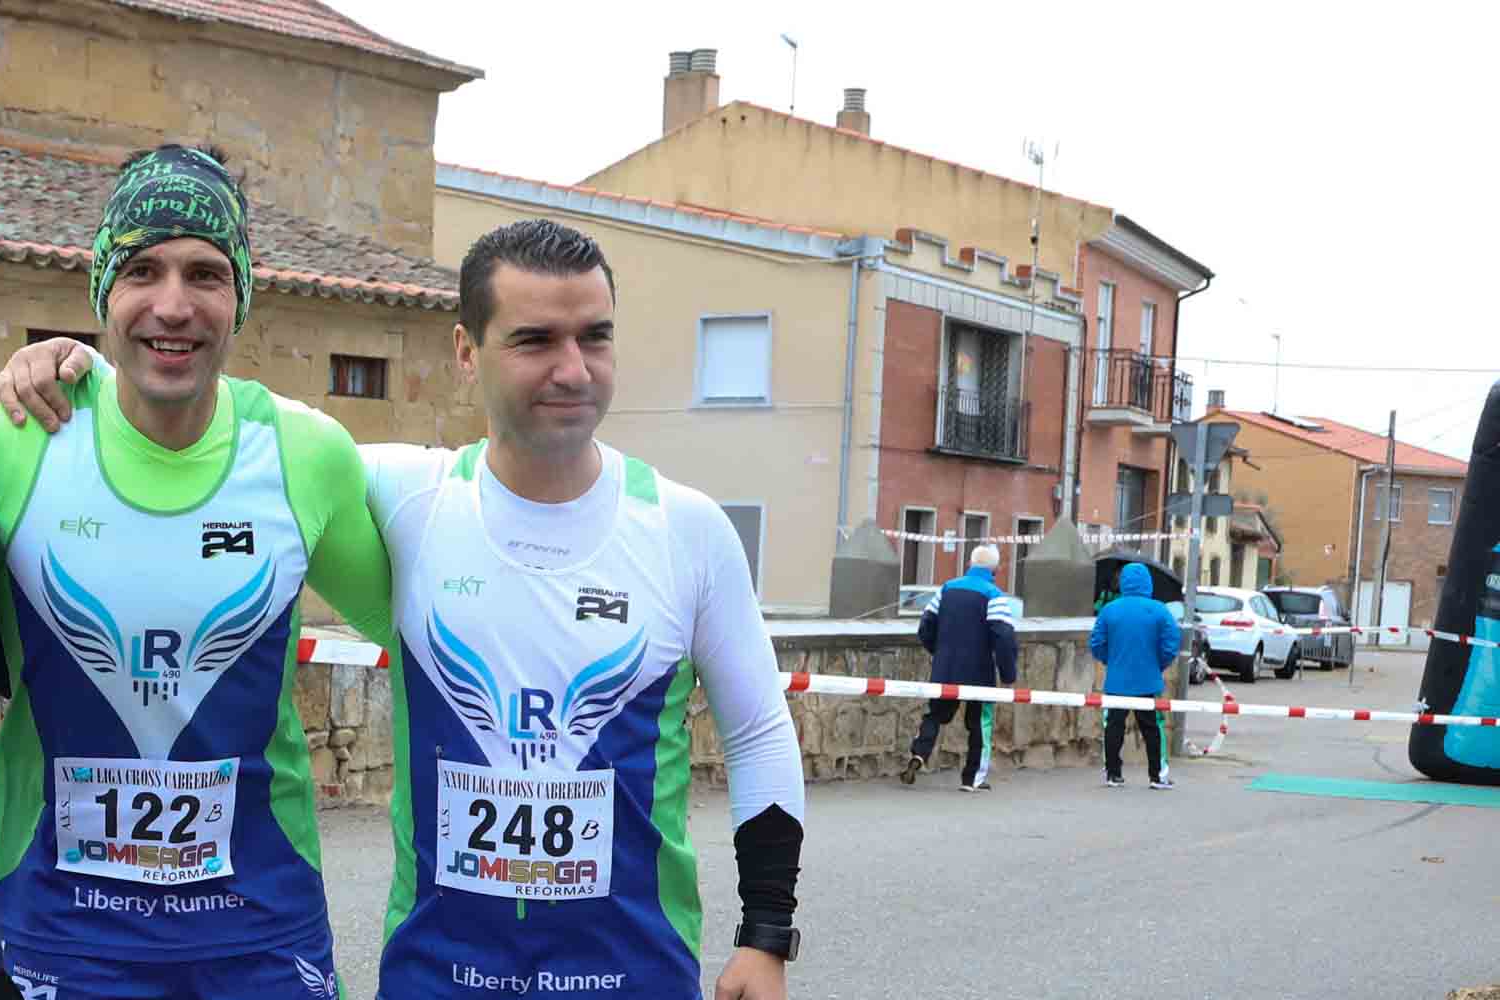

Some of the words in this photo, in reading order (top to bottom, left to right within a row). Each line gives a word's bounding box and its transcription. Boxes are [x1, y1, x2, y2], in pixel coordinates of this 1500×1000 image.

[202, 521, 253, 530] HERBALIFE
[202, 531, 254, 559] 24
[578, 586, 629, 599] HERBALIFE
[576, 596, 629, 624] 24
[162, 670, 181, 678] 490
[97, 767, 122, 785] LIGA
[125, 768, 161, 787] CROSS
[472, 773, 495, 796] LIGA
[498, 778, 534, 799] CROSS
[537, 780, 607, 800] CABRERIZOS
[95, 788, 200, 843] 122
[468, 799, 574, 857] 248
[446, 850, 597, 885] JOMISAGA
[74, 886, 158, 917] Liberty
[164, 893, 245, 913] Runner
[516, 884, 595, 898] REFORMAS
[452, 964, 532, 994] Liberty
[538, 970, 626, 992] Runner
